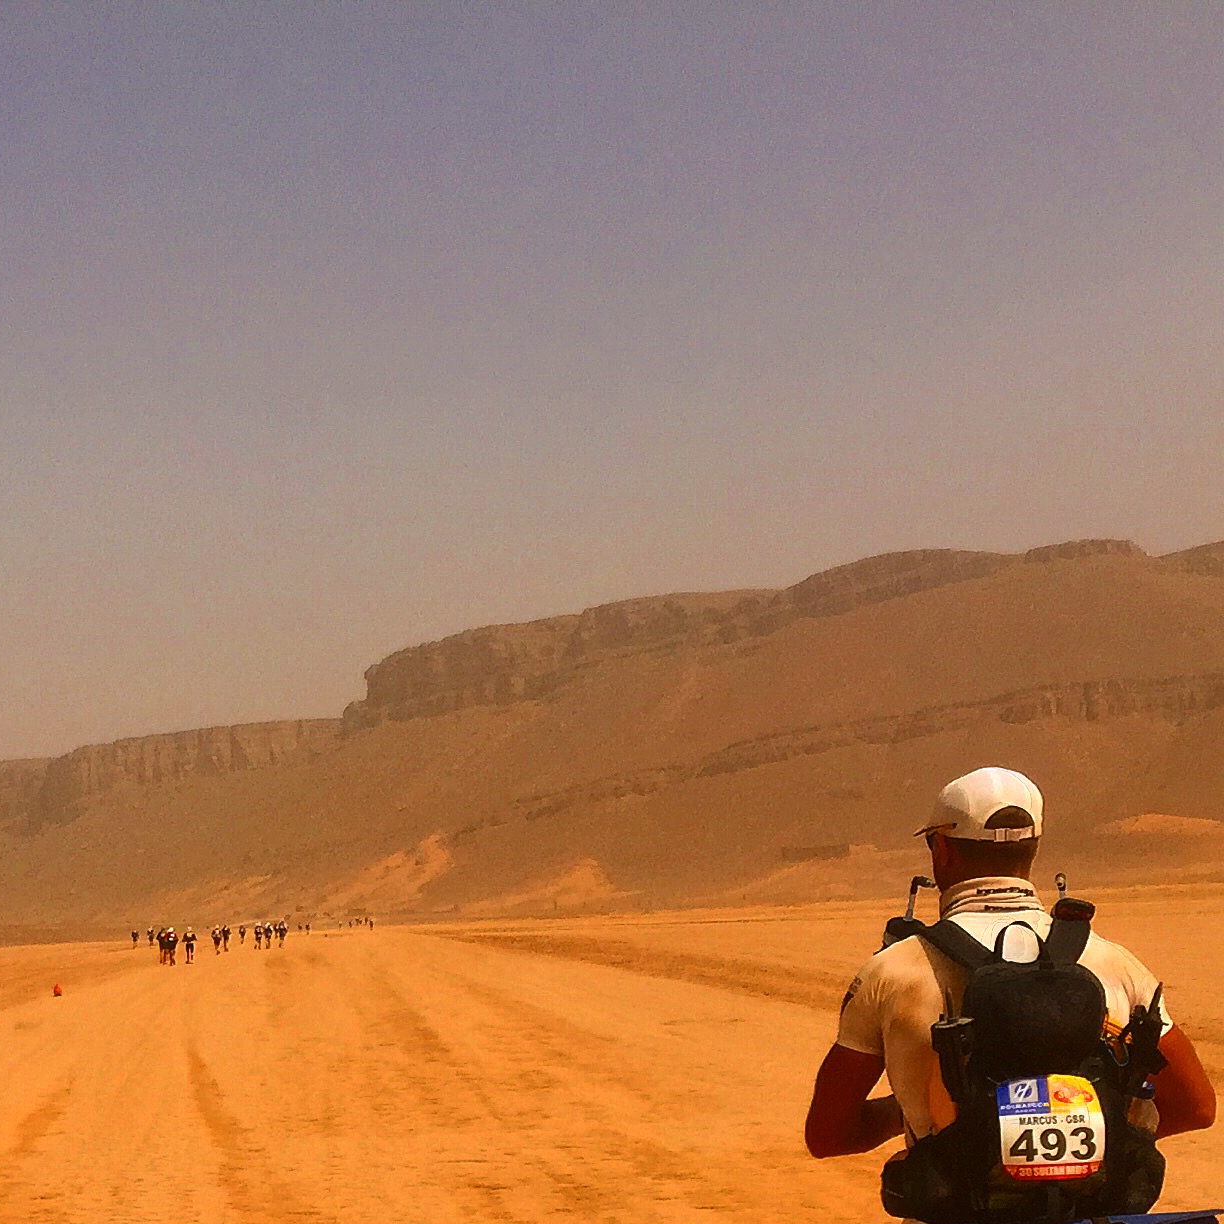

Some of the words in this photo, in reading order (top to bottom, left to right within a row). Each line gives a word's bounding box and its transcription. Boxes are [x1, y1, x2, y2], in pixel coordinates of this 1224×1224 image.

[1019, 1115, 1057, 1126] MARCUS
[1065, 1114, 1086, 1125] GBR
[1009, 1126, 1096, 1162] 493
